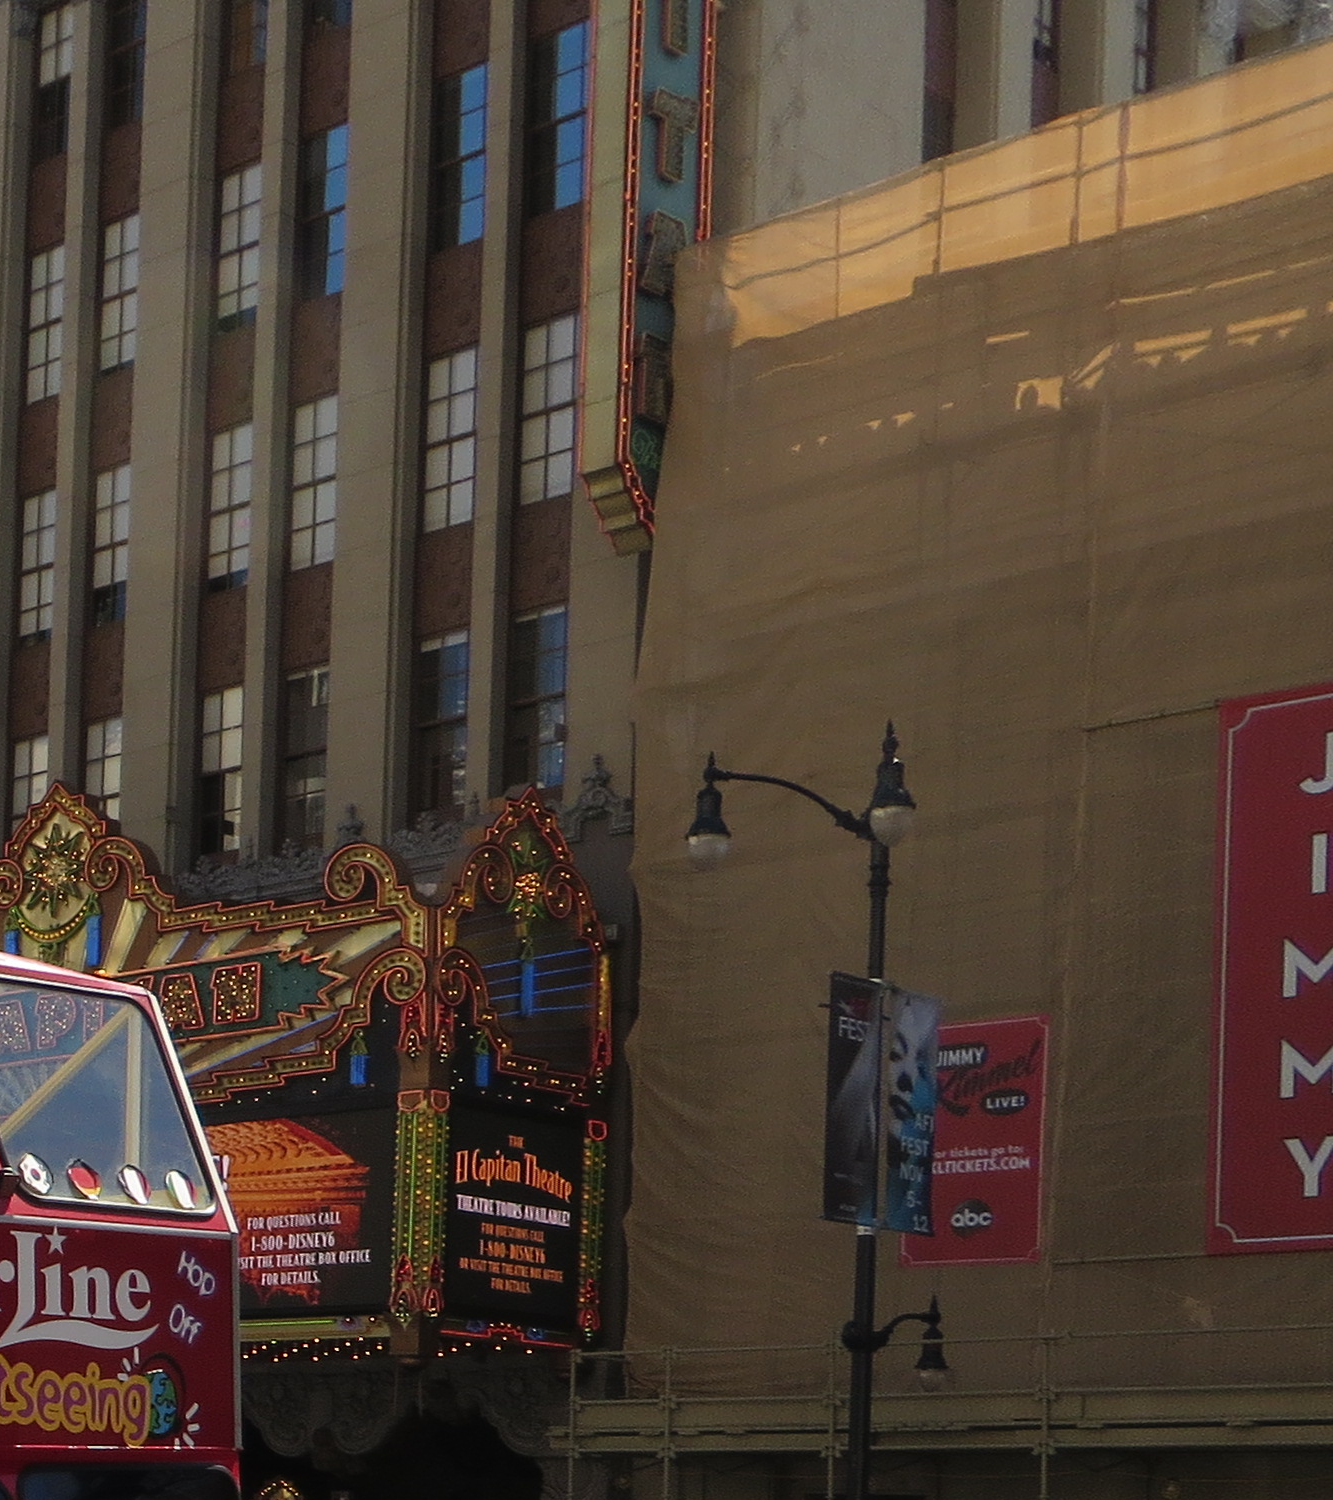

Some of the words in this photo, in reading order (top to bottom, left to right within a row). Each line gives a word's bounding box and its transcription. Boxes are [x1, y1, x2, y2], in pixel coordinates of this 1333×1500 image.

[936, 1046, 985, 1067] JIMMY
[986, 1096, 1025, 1109] LIVE!
[934, 1150, 946, 1159] or
[472, 1148, 521, 1187] Capitan
[524, 1153, 573, 1204] Theatre
[247, 1217, 266, 1230] FOR
[266, 1213, 316, 1231] QUESTIONS
[318, 1211, 341, 1225] CALL
[951, 1208, 993, 1227] abc
[251, 1232, 335, 1252] 1-800-DISNEY6
[239, 1257, 255, 1270] SIT
[256, 1255, 274, 1269] THE
[276, 1252, 316, 1268] THEATRE
[318, 1250, 337, 1265] BOX
[339, 1249, 371, 1264] OFFICE
[177, 1250, 217, 1299] Hop
[261, 1272, 279, 1286] FOR
[168, 1302, 204, 1345] Off
